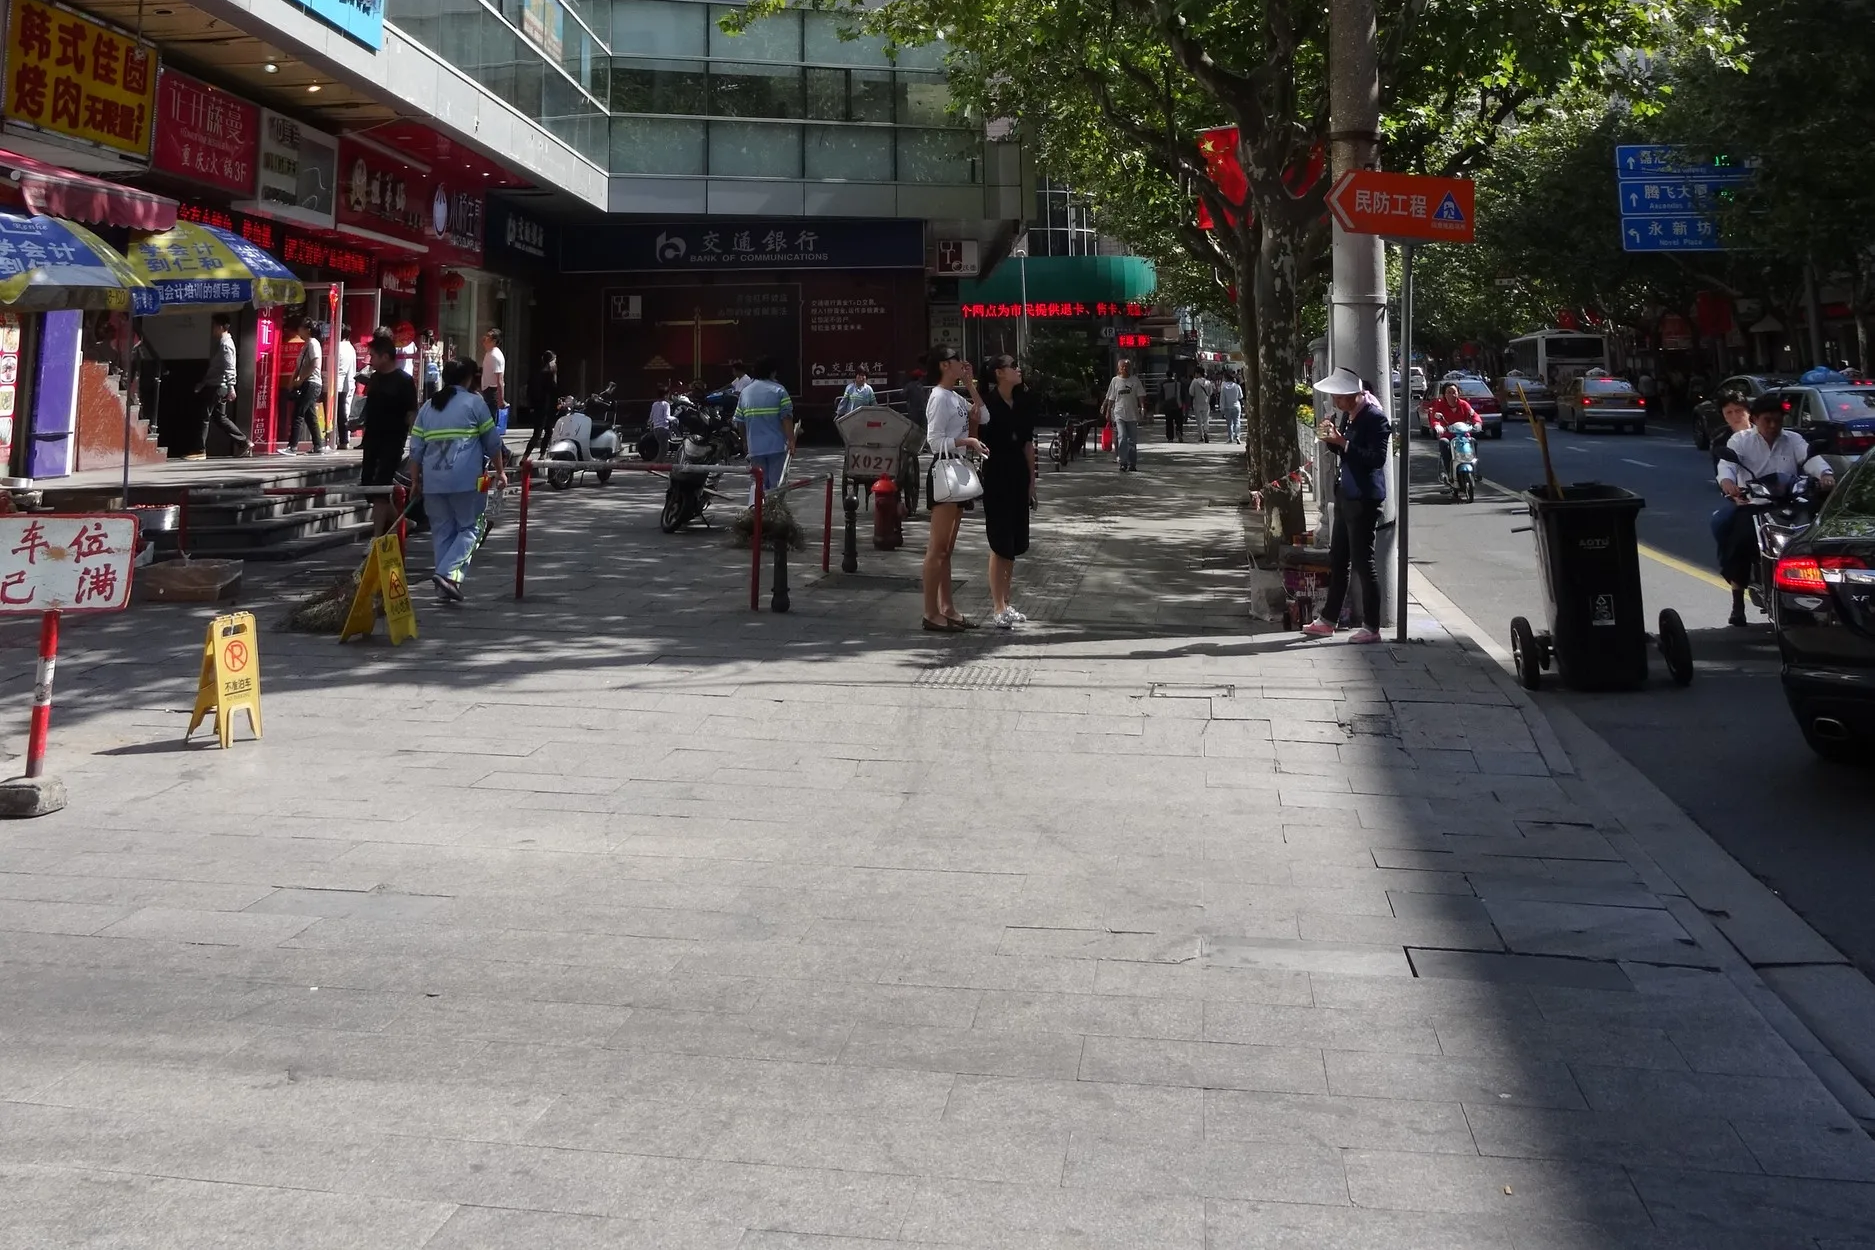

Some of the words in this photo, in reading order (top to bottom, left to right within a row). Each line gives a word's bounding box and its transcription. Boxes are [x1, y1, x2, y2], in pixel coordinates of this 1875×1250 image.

[1355, 189, 1427, 218] 民防工程
[1648, 221, 1712, 236] 永新坊
[140, 242, 215, 257] 学会计
[145, 257, 224, 272] 到仁和
[690, 254, 717, 262] BANK
[722, 254, 736, 262] OF
[740, 253, 829, 262] COMMUNICATIONS
[851, 453, 894, 471] X027
[11, 520, 114, 564] 车位
